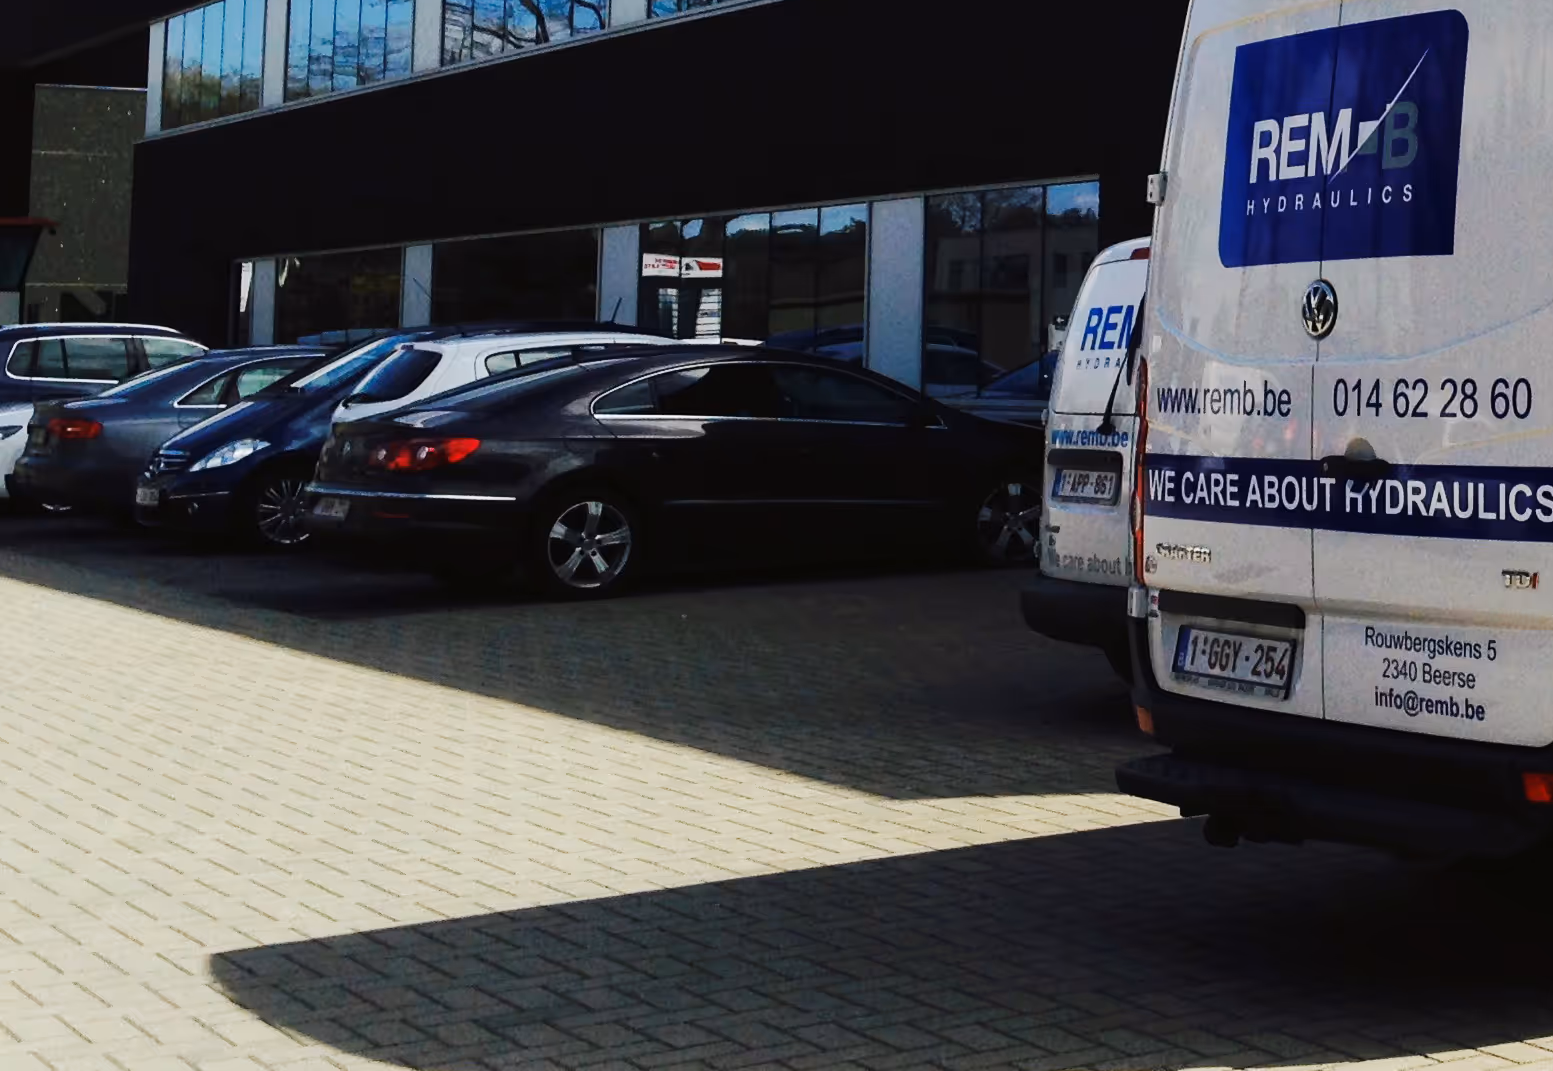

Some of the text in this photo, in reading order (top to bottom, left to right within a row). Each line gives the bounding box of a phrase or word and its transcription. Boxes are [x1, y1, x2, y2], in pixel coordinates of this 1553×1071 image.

[1246, 184, 1414, 216] HYDRAULICS
[1156, 380, 1292, 418] www.remb.be
[1333, 377, 1533, 420] 014 62 28 60
[1149, 469, 1176, 502] WE
[1181, 471, 1240, 506] CARE
[1245, 475, 1336, 512] ABOUT
[1501, 568, 1540, 590] TDI
[1364, 626, 1497, 661] Rouwbergskens 5
[1382, 657, 1476, 689] 2340 Beerse
[1374, 685, 1486, 721] info@remb.be
